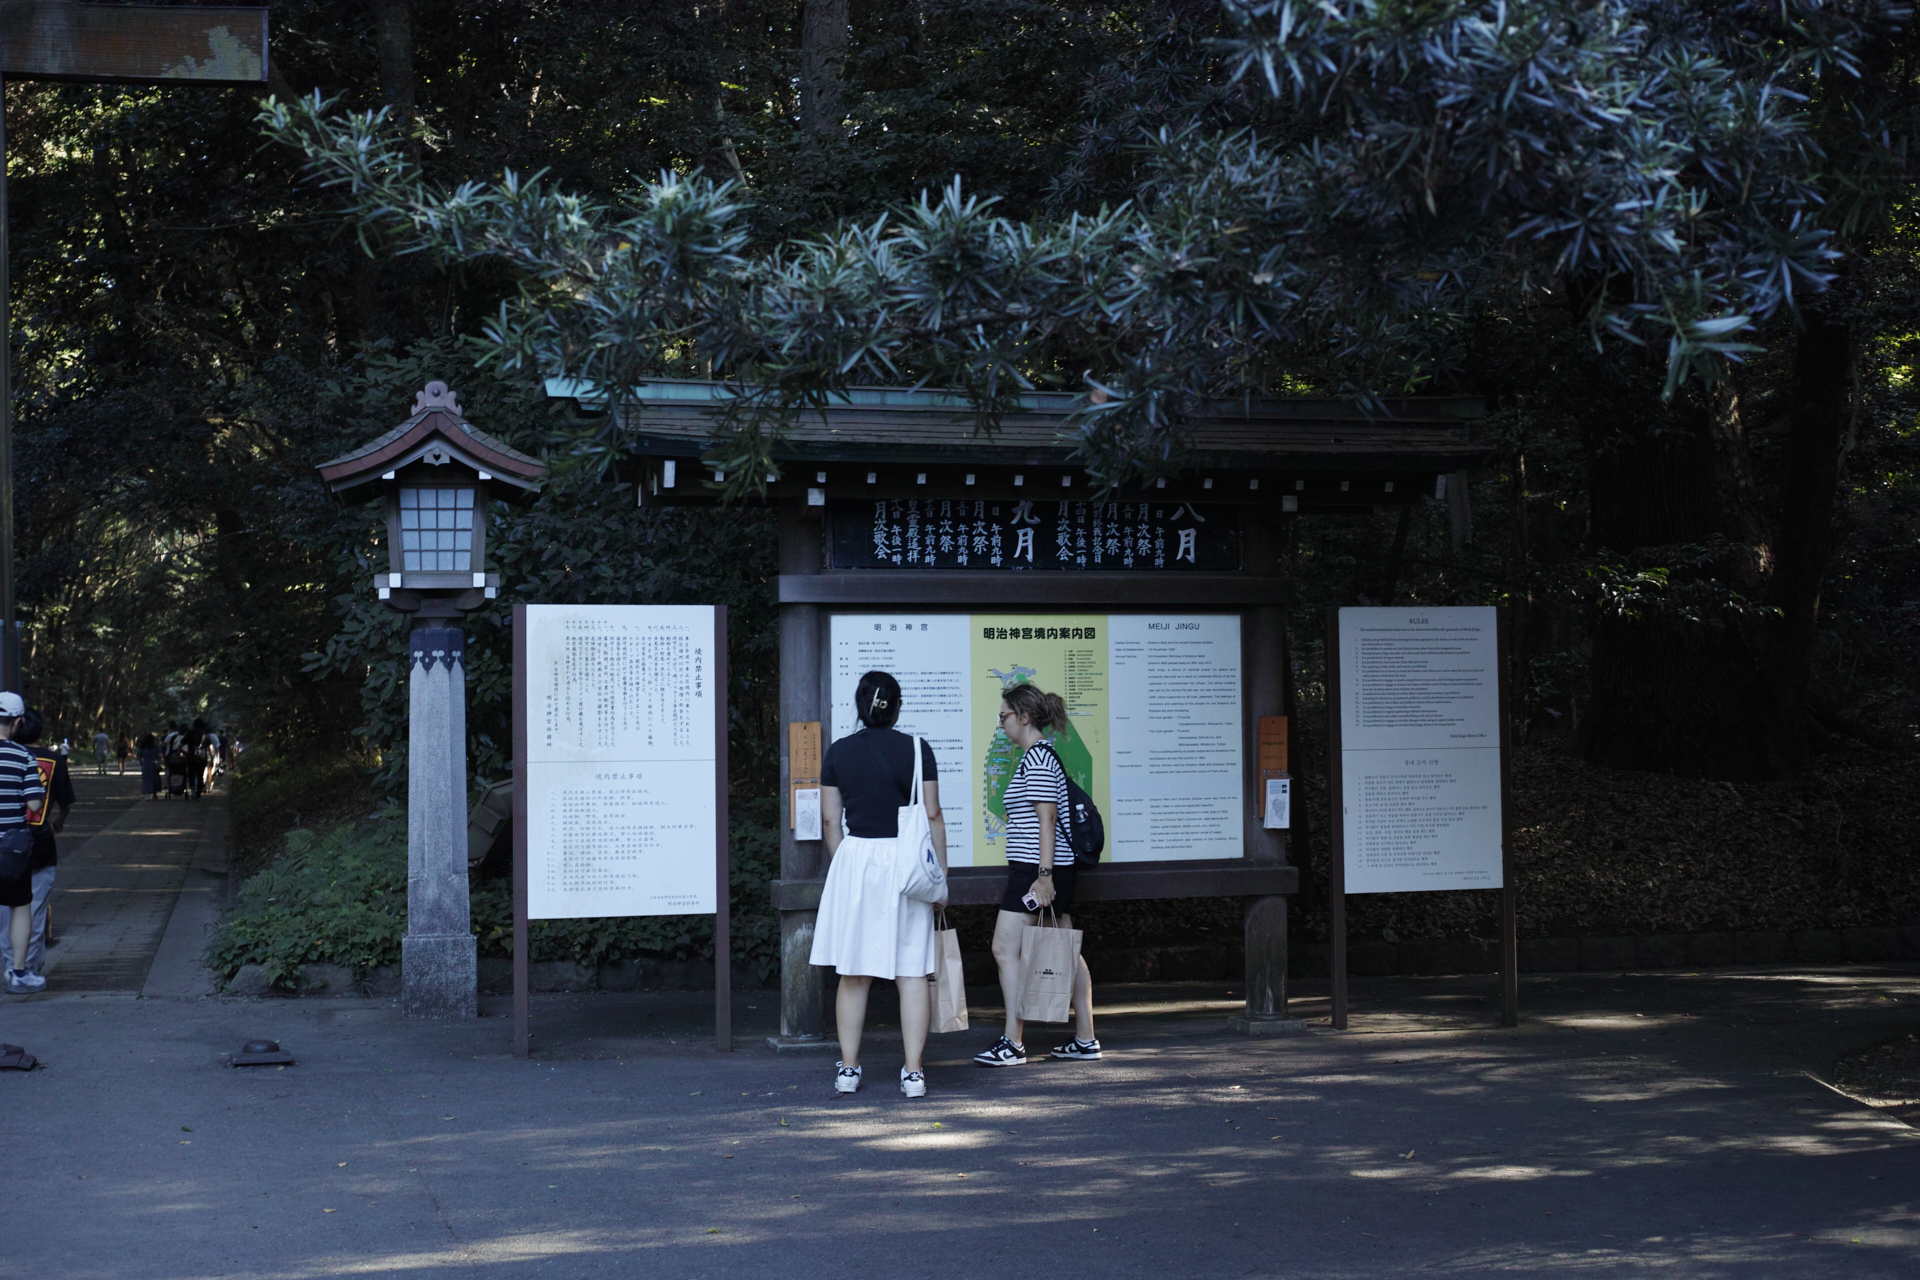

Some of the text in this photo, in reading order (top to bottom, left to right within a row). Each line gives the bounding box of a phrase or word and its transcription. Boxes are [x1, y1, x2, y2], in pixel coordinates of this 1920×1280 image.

[873, 500, 891, 560] 月次歌会
[924, 523, 937, 567] 午前九時
[939, 500, 956, 554] 月次祭
[957, 523, 969, 566] 午前九時
[972, 500, 990, 555] 月次祭
[990, 523, 1003, 567] 午前九時
[1010, 500, 1041, 563] 九月
[1055, 501, 1074, 562] 月次歌会
[1105, 502, 1122, 557] 月次祭
[1136, 502, 1153, 557] 月次祭
[1170, 502, 1206, 564] 八月
[874, 623, 928, 631] 明治神宮
[983, 627, 1096, 640] 明治神宮境内案内図
[1148, 622, 1200, 630] MEIJI JINGU
[694, 647, 703, 698] 境内禁止事項
[595, 773, 643, 781] 境内禁止事项
